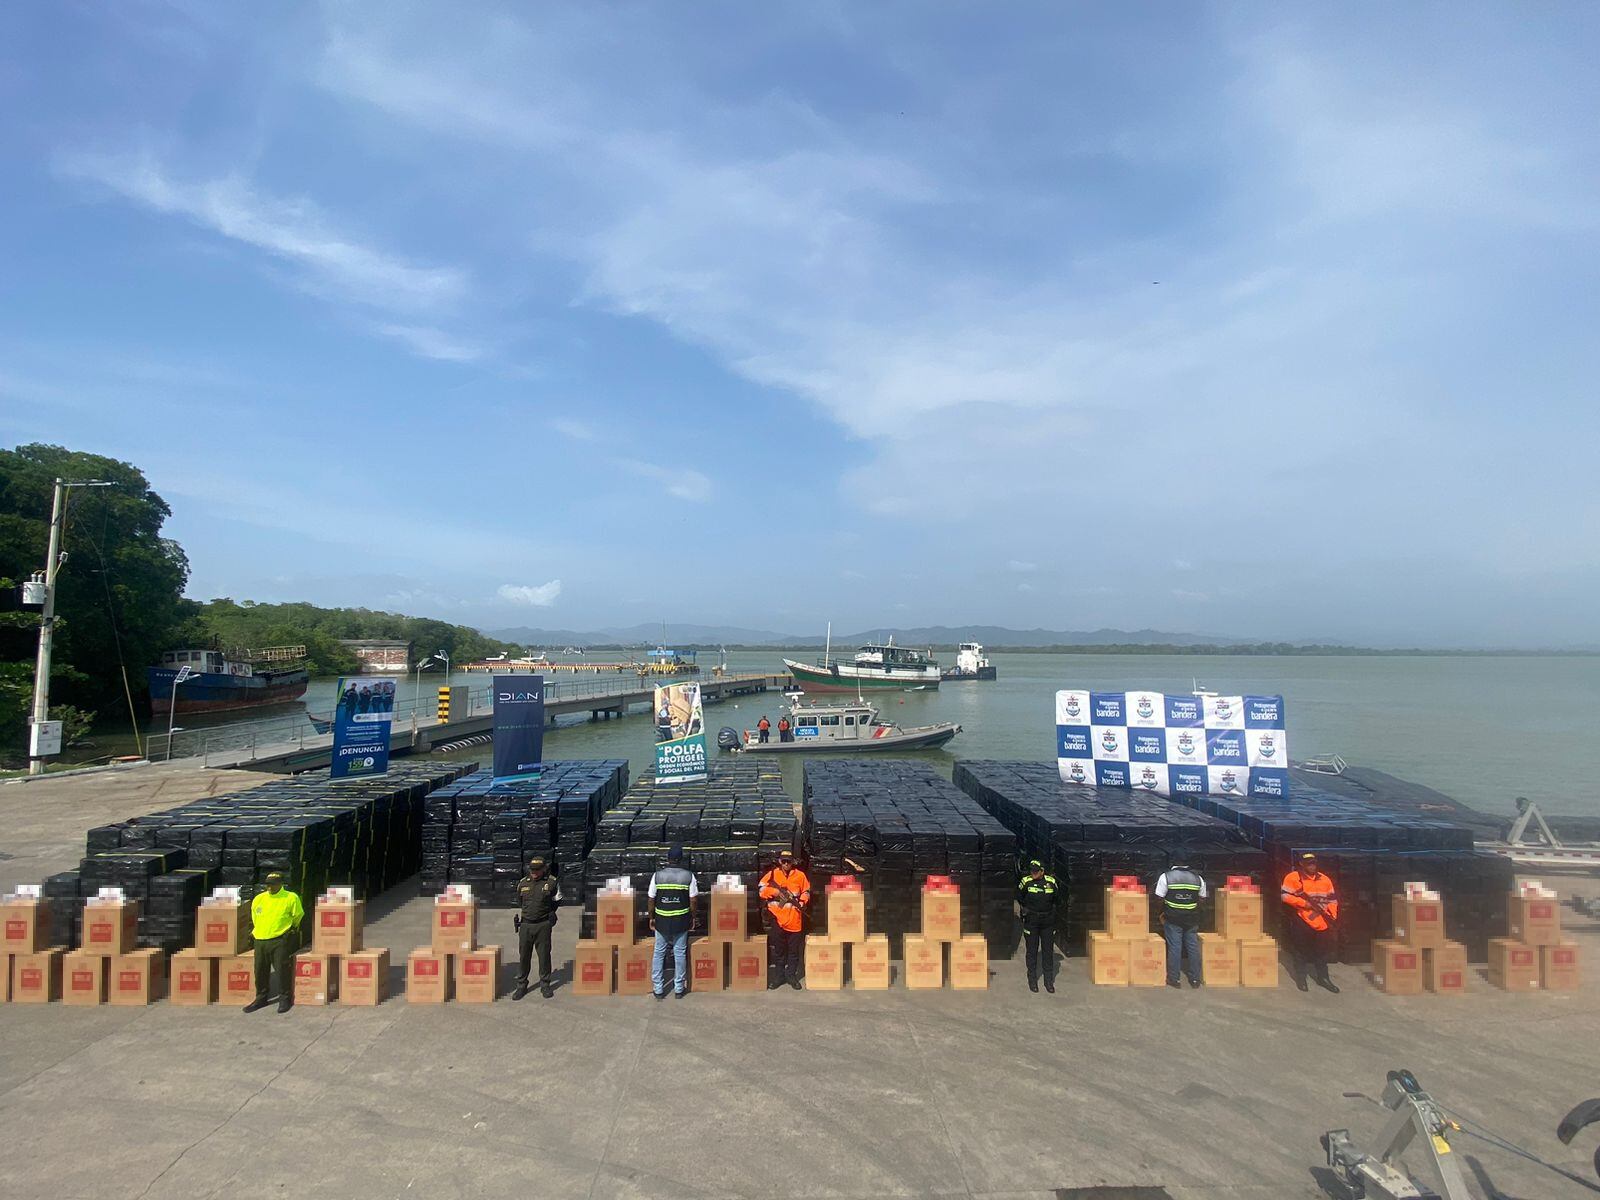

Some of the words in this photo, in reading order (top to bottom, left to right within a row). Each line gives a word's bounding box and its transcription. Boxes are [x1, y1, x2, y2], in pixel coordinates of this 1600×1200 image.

[499, 692, 539, 701] DIAN
[1096, 708, 1120, 718] bandera
[1171, 709, 1197, 719] bandera
[1250, 710, 1278, 720] bandera
[339, 745, 384, 756] ¡DENUNCIA!
[664, 743, 704, 756] POLFA
[1064, 741, 1087, 750] bandera
[1134, 743, 1160, 754] bandera
[1213, 746, 1240, 756] bandera
[659, 755, 695, 763] PROTEGE
[696, 753, 705, 761] EL
[1175, 782, 1202, 792] bandera
[1254, 784, 1282, 795] bandera
